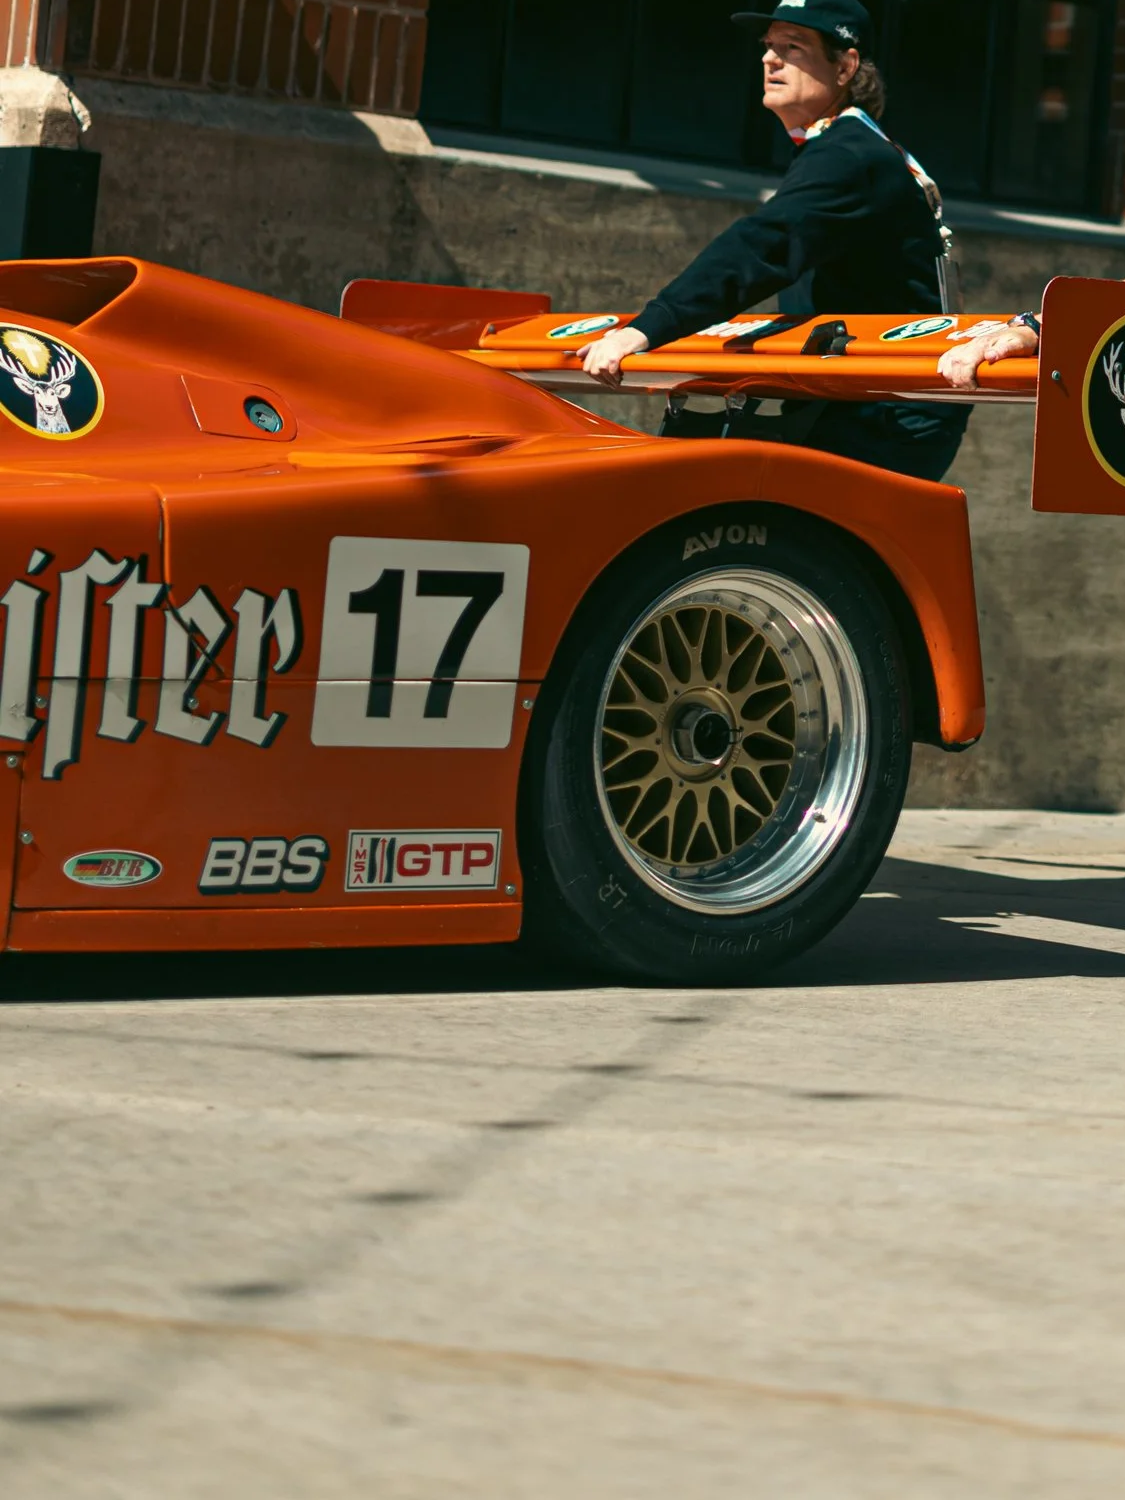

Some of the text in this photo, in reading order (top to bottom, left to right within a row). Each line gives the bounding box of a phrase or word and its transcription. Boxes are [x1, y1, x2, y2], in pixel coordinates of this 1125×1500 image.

[682, 524, 767, 561] AVON
[348, 568, 504, 718] 17
[97, 858, 145, 877] BFR
[197, 835, 331, 894] BBS
[353, 837, 367, 884] IMSA
[396, 842, 494, 877] GTP
